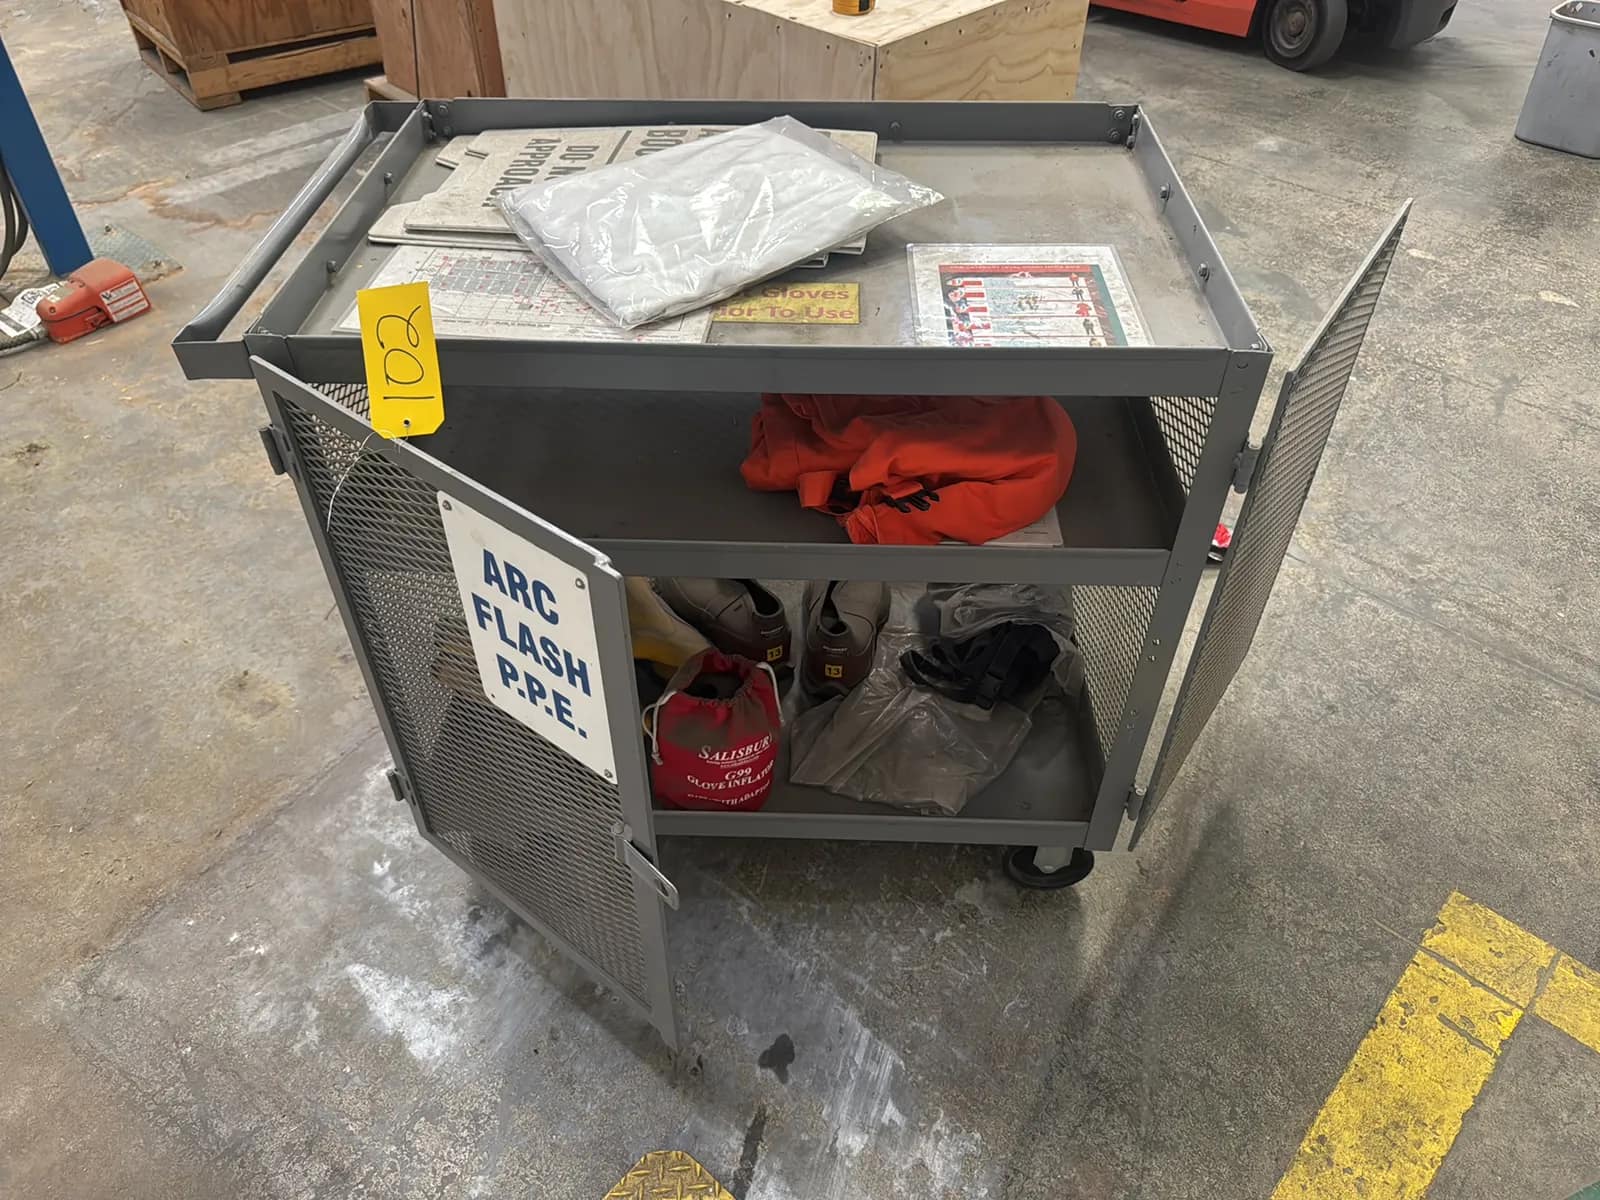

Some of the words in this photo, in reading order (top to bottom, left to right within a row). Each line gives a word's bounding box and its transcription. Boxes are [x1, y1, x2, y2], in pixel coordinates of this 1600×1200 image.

[711, 304, 757, 317] ior
[765, 304, 797, 318] To
[805, 306, 855, 319] Use
[761, 287, 849, 299] Gloves
[376, 305, 435, 400] 102
[483, 548, 559, 625] ARC
[471, 592, 592, 697] FLASH
[496, 653, 588, 739] P.P.E.
[687, 775, 727, 790] GLOVE
[724, 767, 752, 781] G99
